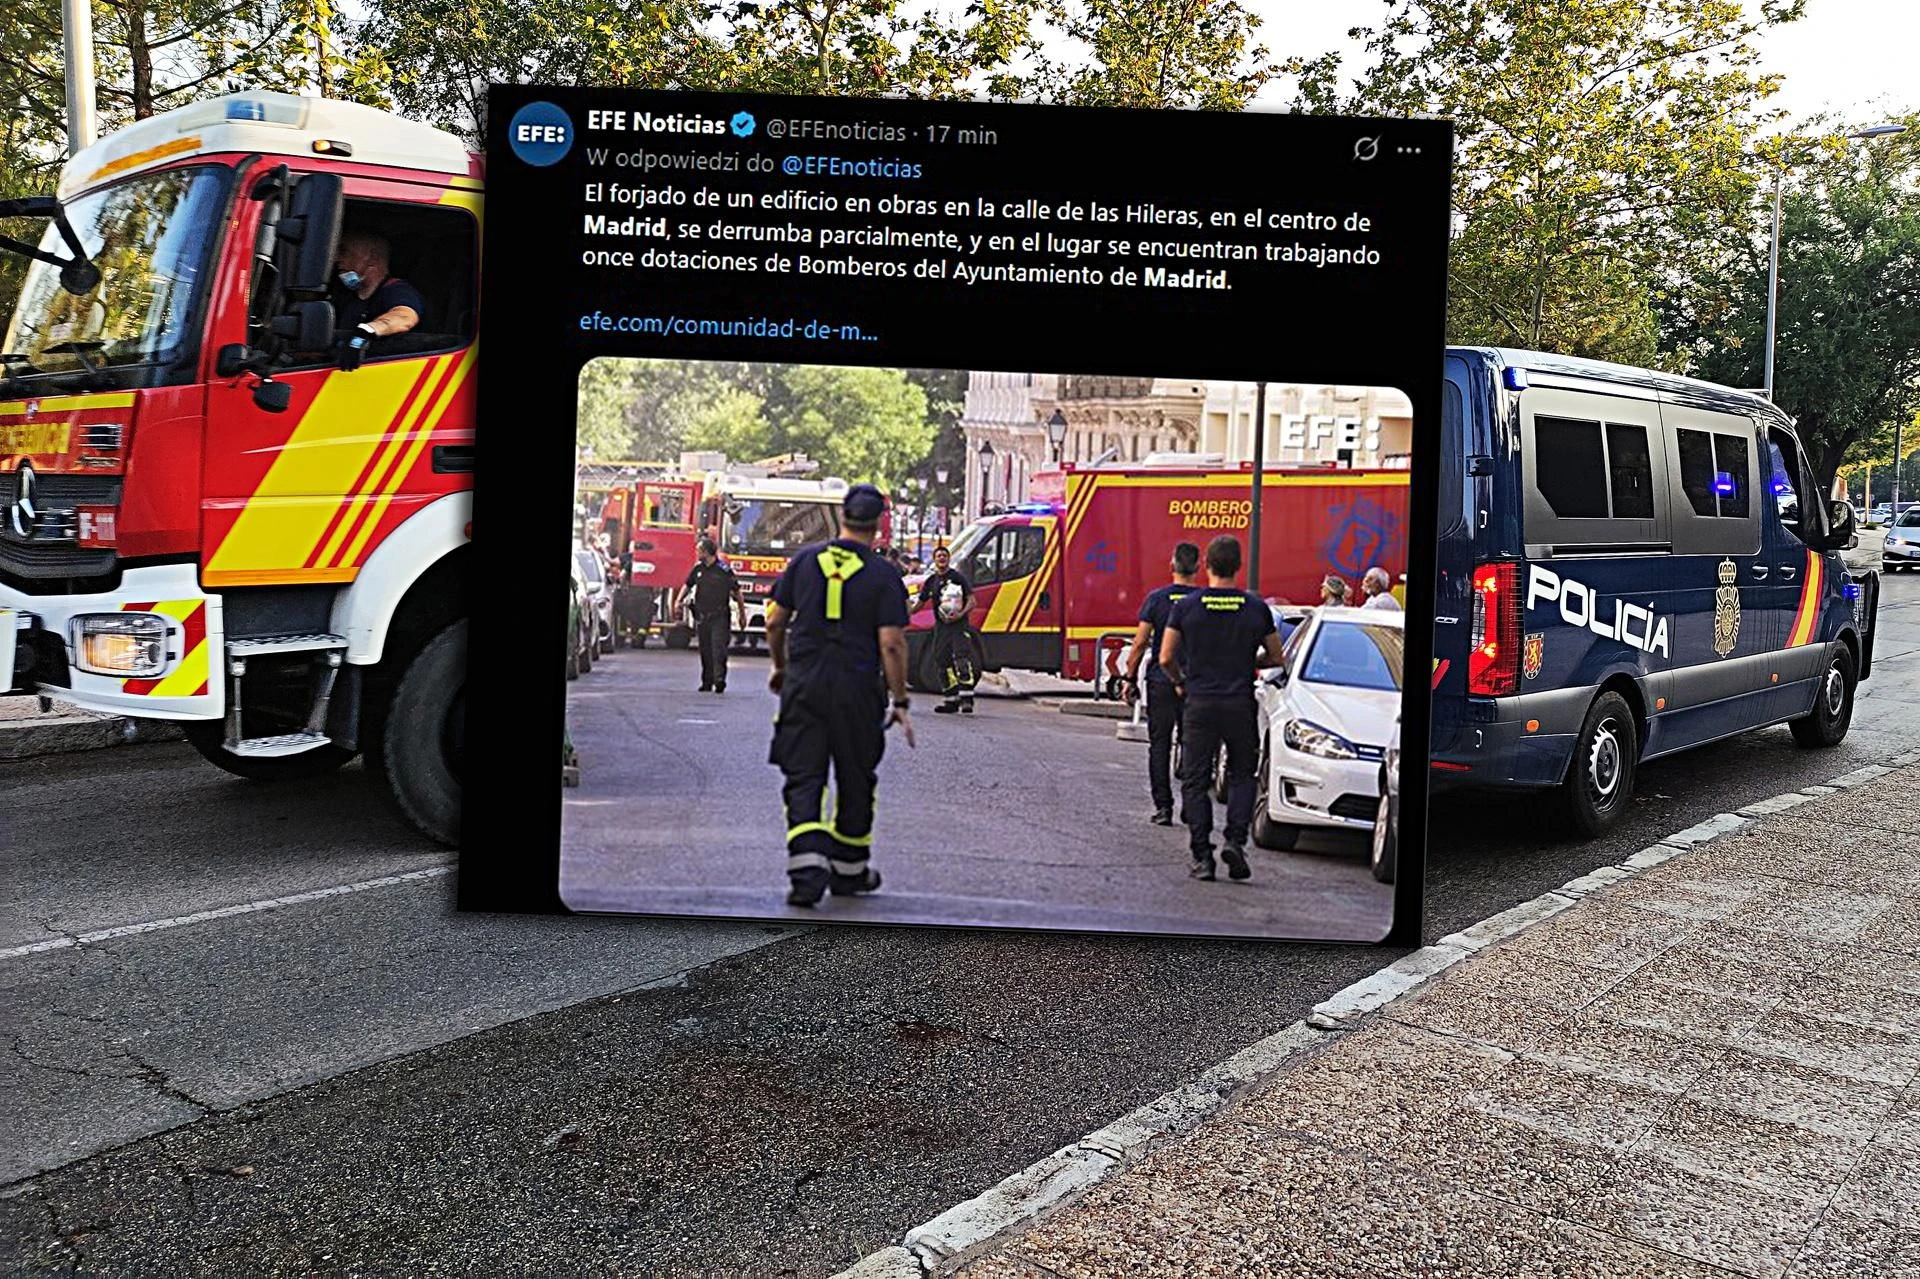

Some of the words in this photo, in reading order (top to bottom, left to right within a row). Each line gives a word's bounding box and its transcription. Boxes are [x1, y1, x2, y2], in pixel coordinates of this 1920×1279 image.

[1168, 500, 1262, 514] BOMBERO
[1183, 515, 1249, 528] MADRID
[1527, 564, 1669, 659] POLICÍA
